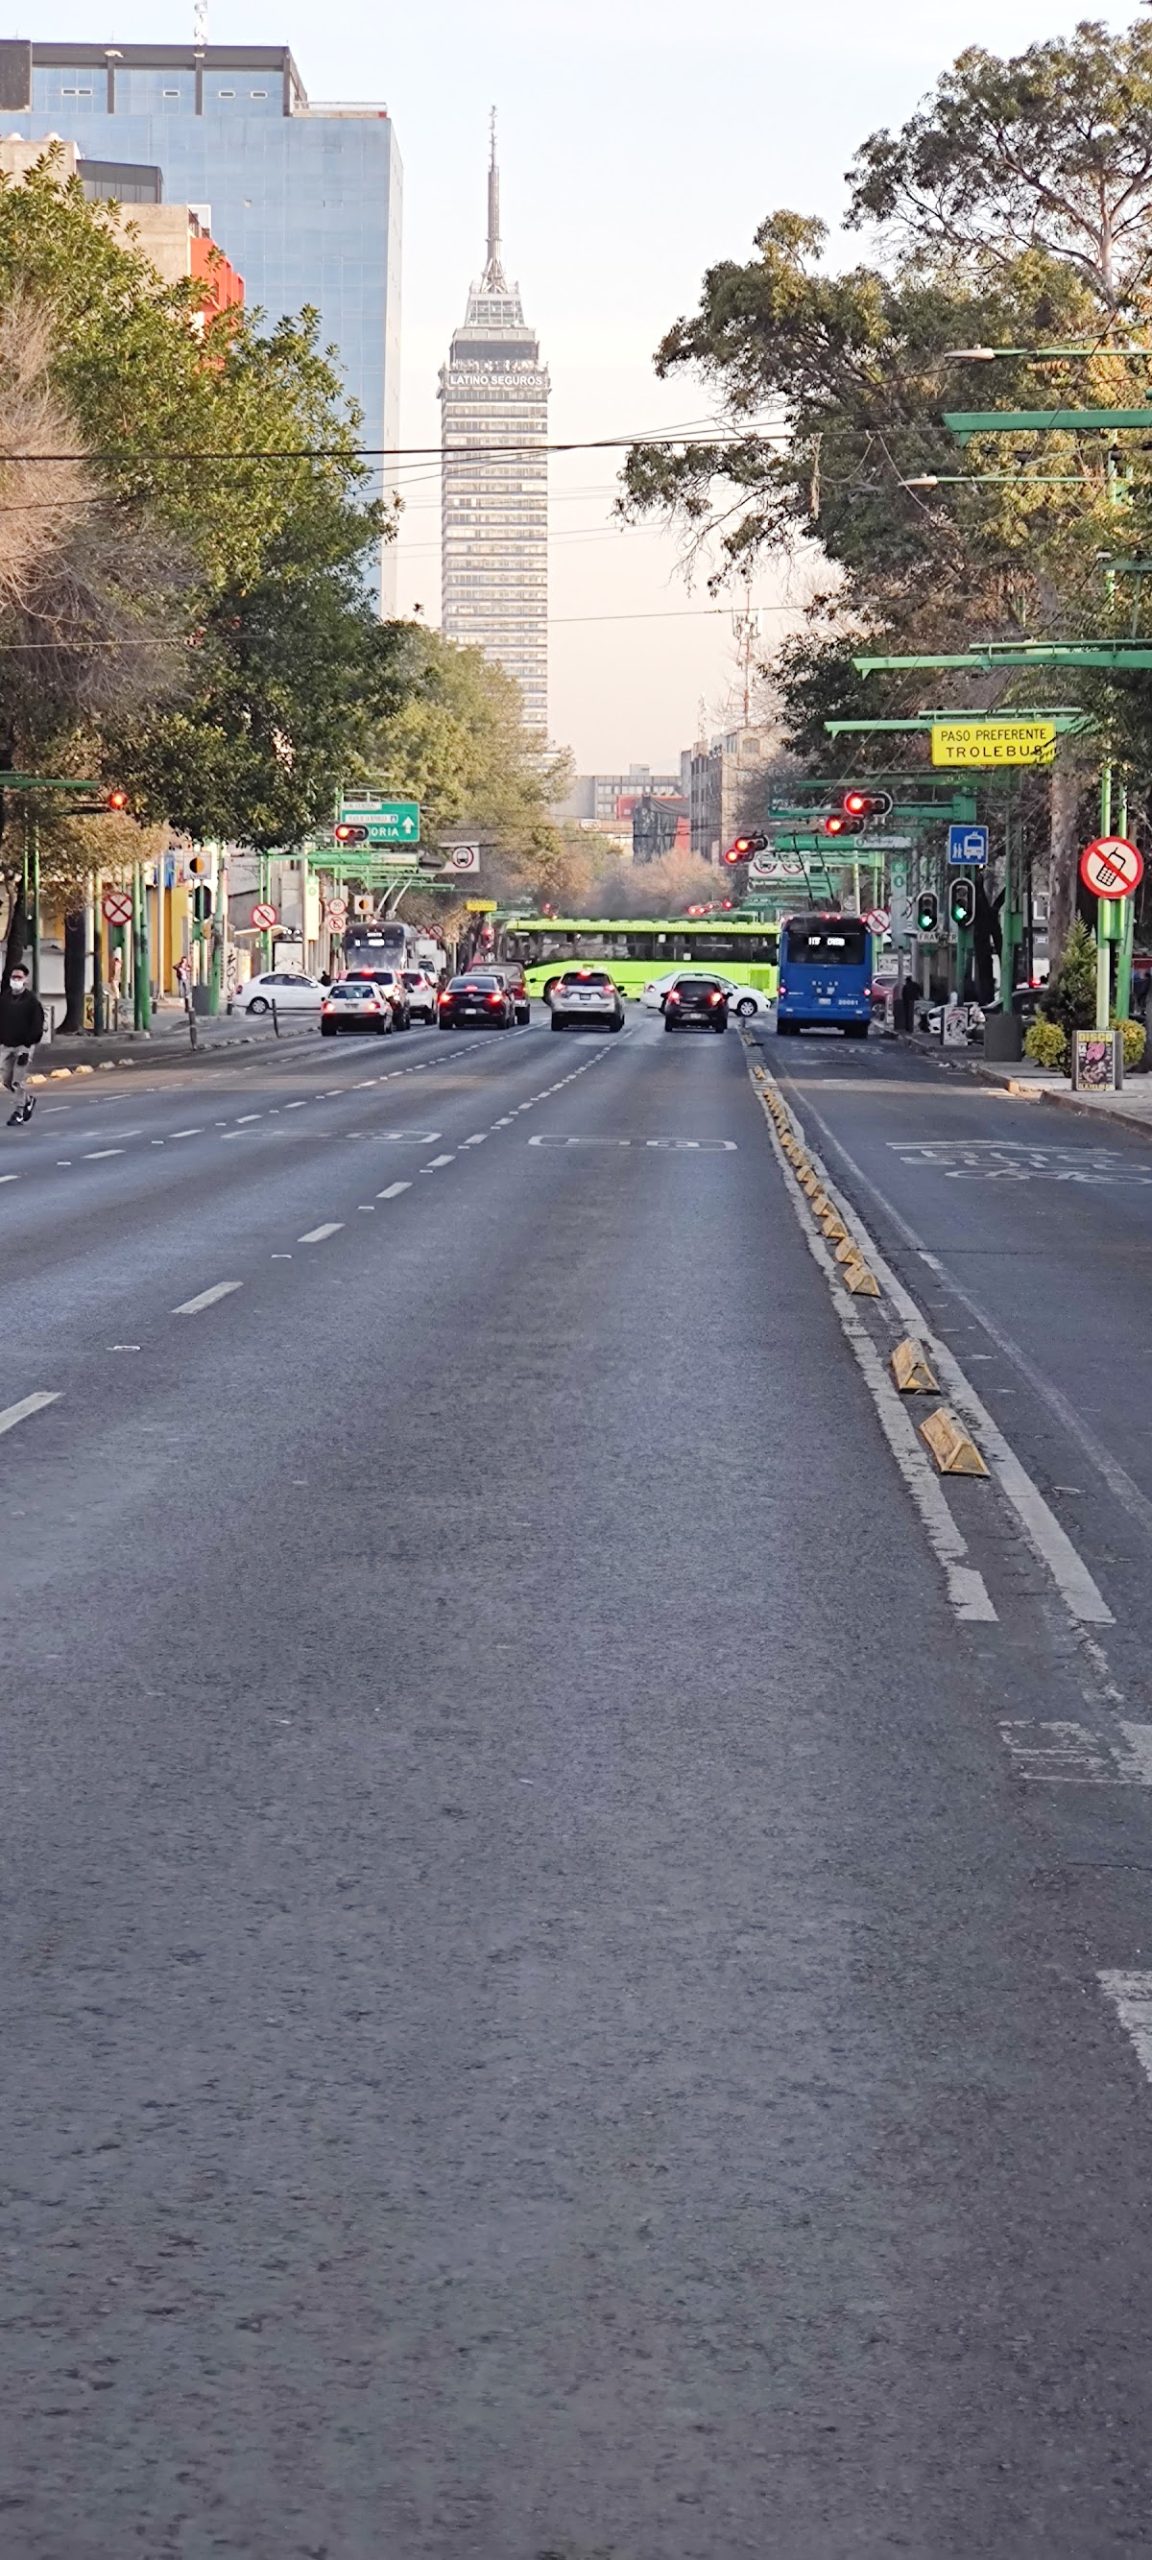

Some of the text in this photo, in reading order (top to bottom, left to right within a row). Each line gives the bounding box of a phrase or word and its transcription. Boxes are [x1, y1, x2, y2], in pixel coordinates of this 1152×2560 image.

[450, 375, 543, 386] LATINO SEGUROS
[940, 727, 1047, 742] PASO PREFERENTE
[945, 745, 1043, 758] TROLEBUS
[371, 827, 400, 837] ORIA
[1078, 1032, 1113, 1042] DISCO
